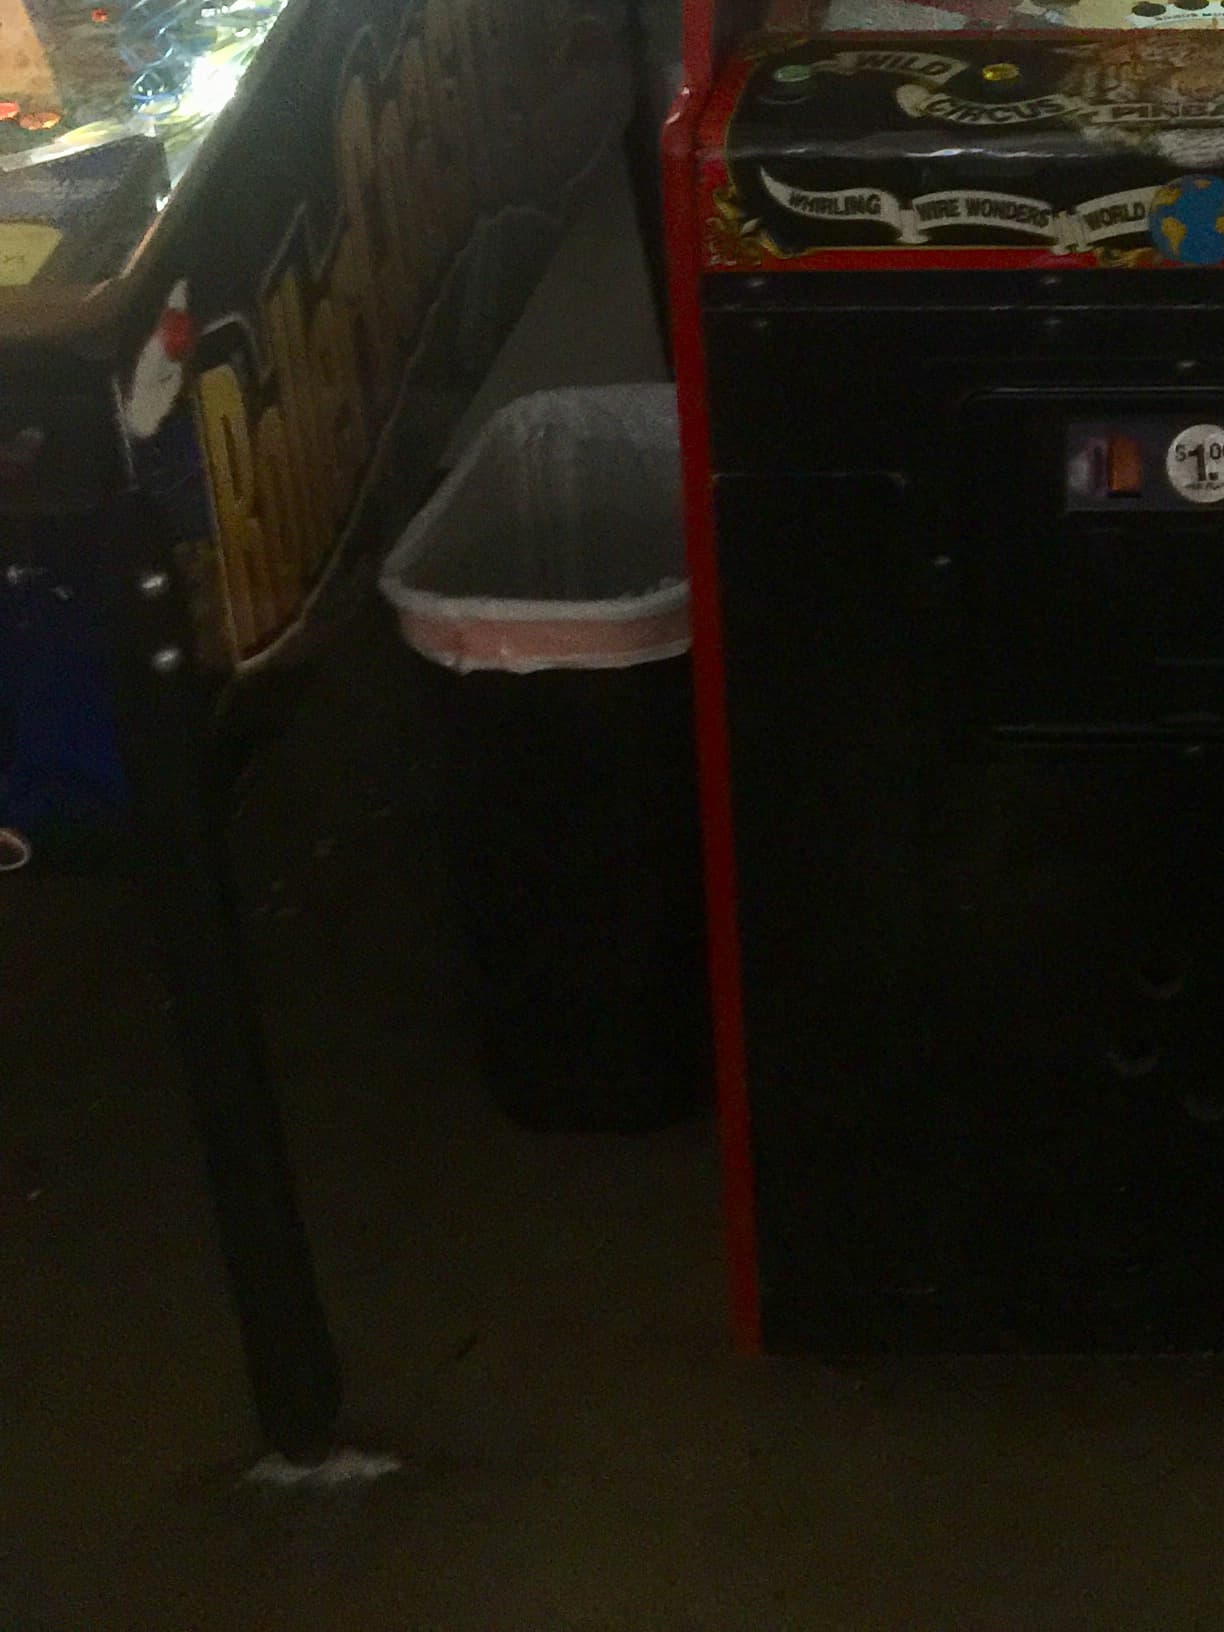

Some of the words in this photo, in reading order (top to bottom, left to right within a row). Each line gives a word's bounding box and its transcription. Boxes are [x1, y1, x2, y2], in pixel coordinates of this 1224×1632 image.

[926, 98, 1066, 122] CIRCUS
[788, 191, 882, 216] WHIRLING
[915, 198, 962, 222] WIRE
[1082, 201, 1147, 231] WORLD
